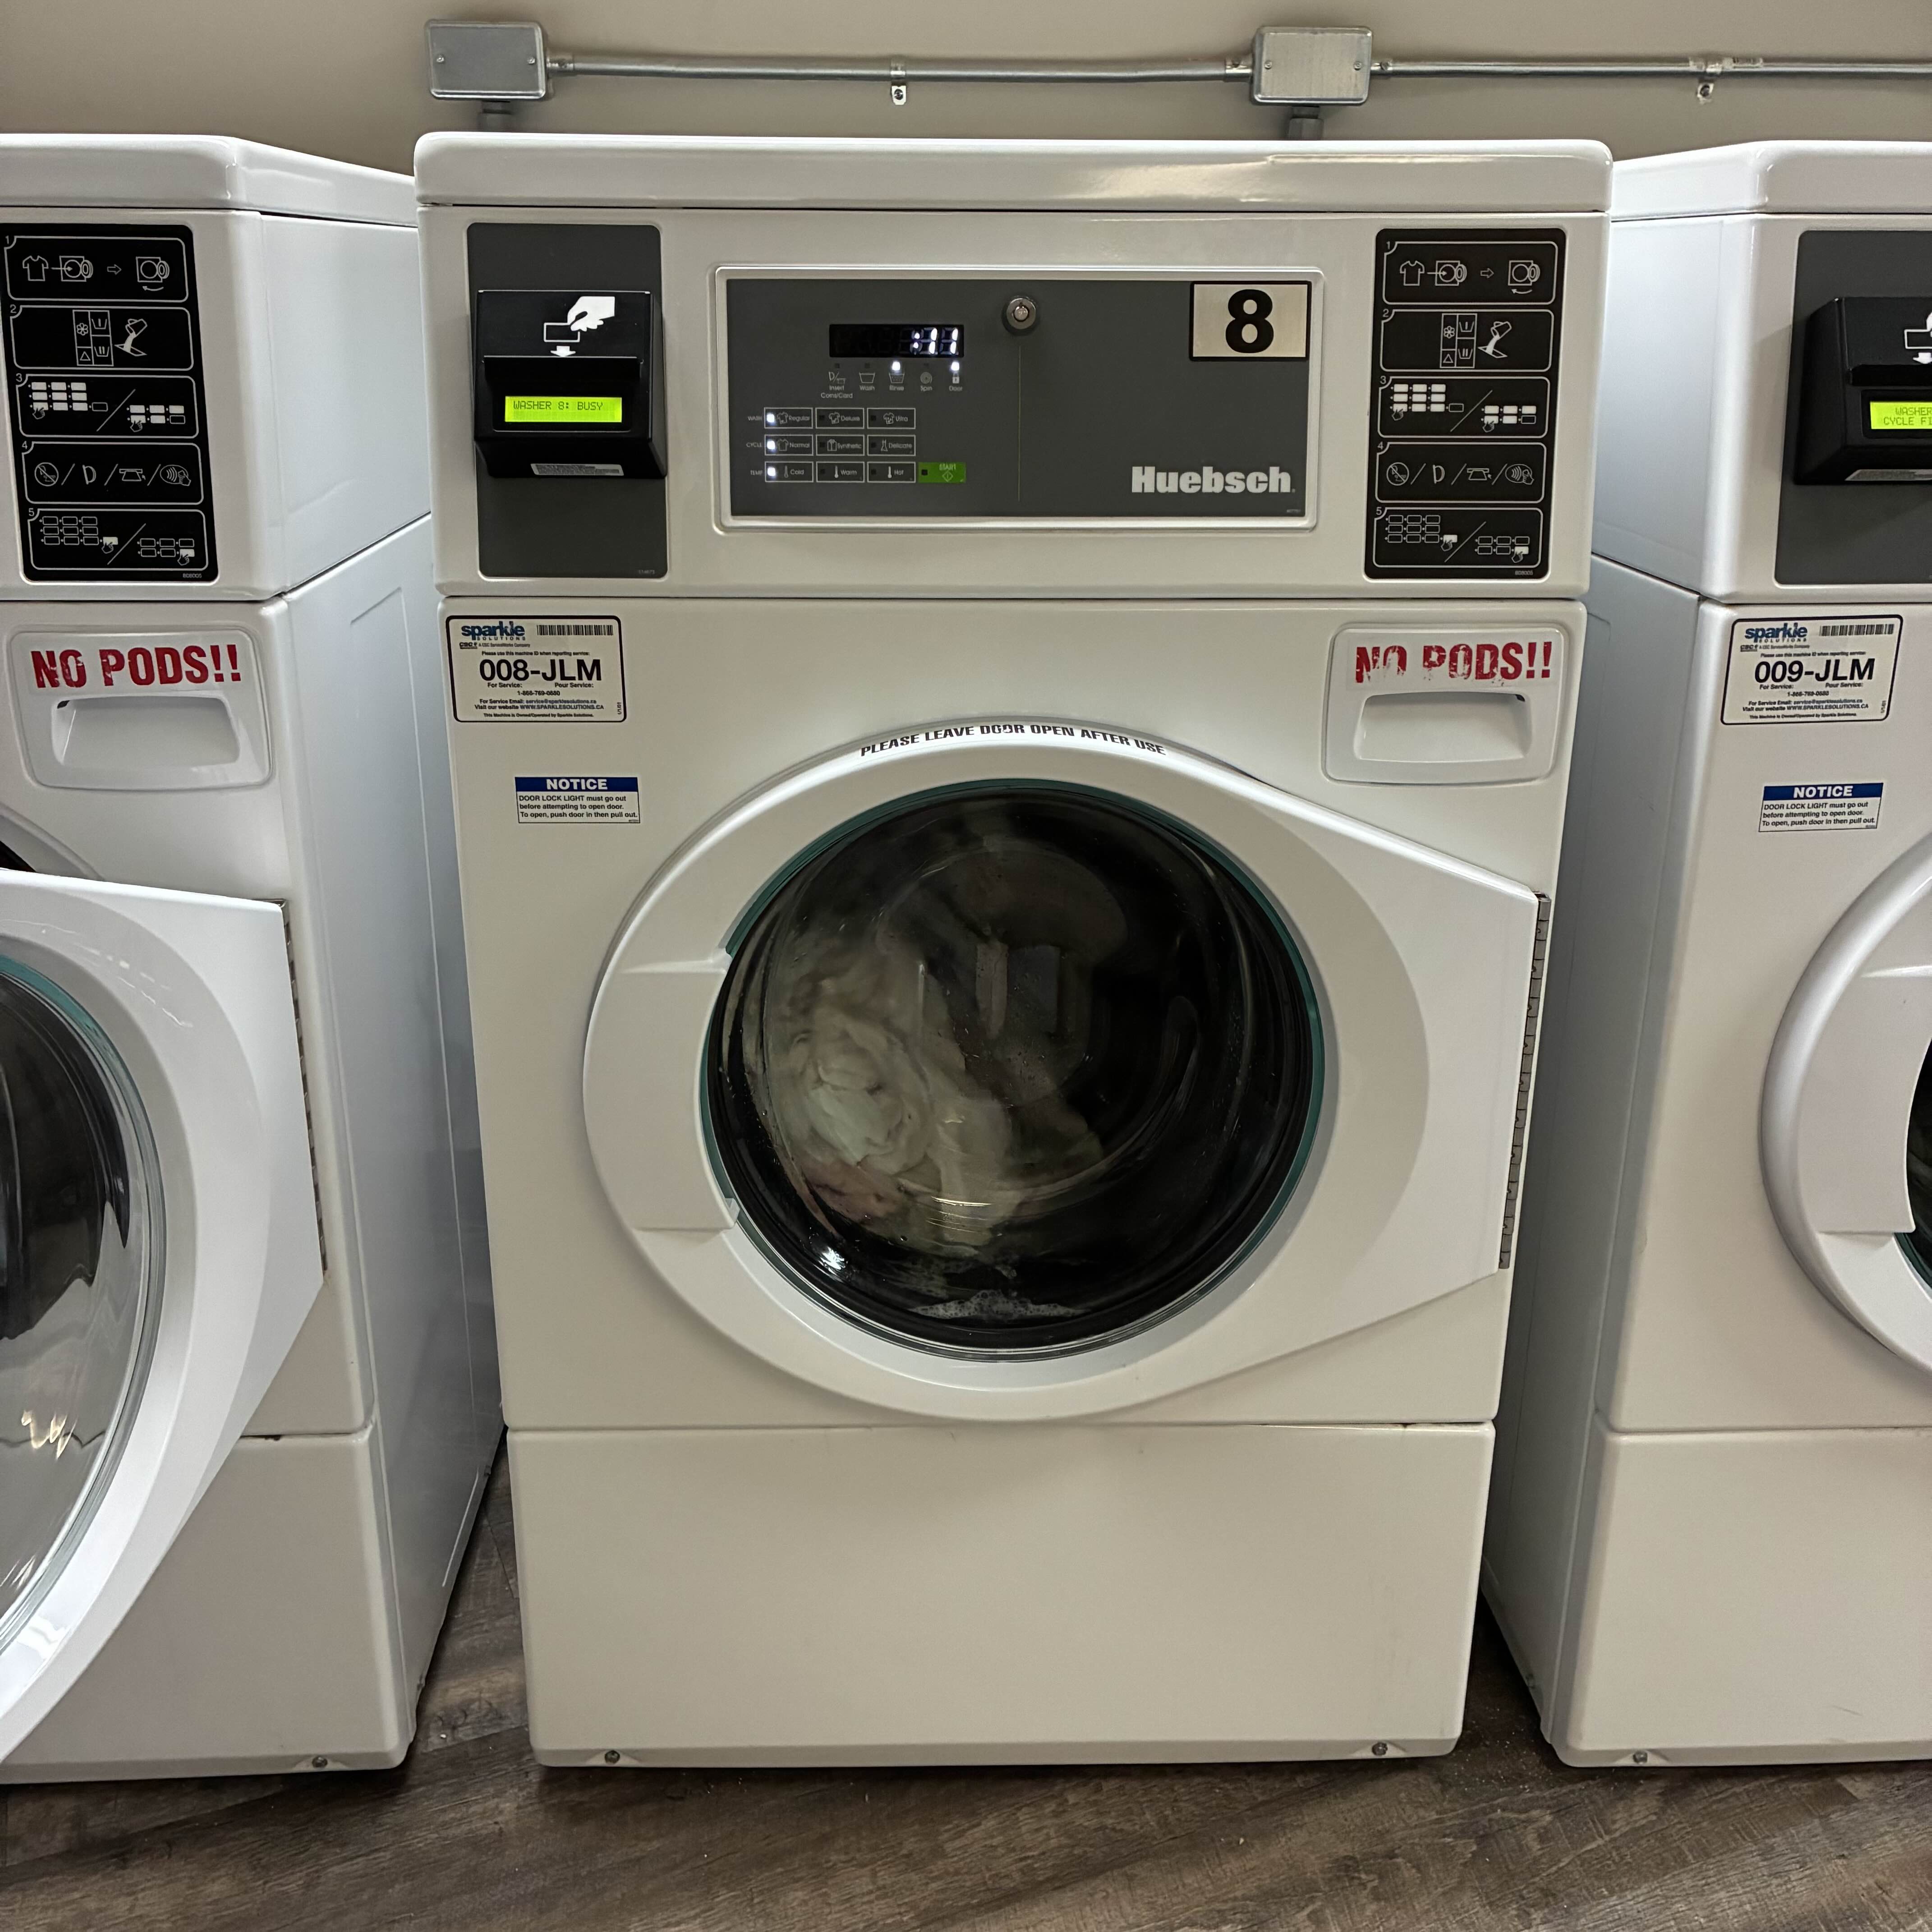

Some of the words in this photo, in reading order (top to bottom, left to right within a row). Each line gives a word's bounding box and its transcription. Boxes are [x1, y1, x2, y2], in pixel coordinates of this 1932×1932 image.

[5, 235, 9, 244] 1
[10, 304, 17, 313] 2
[1225, 289, 1274, 353] 8
[16, 373, 22, 382] 3
[1380, 376, 1386, 384] 3
[513, 400, 552, 409] WASHER
[558, 401, 569, 410] 8:
[577, 401, 603, 410] BUSY
[1884, 417, 1915, 425] CYCLE
[22, 442, 28, 450] 4
[1132, 466, 1291, 494] Huebsch
[28, 508, 34, 516] 5
[461, 621, 525, 640] sparkle
[1744, 622, 1808, 643] sparkle
[31, 649, 87, 688] NO
[99, 644, 241, 686] PODS!!
[1423, 641, 1552, 681] PODS!!
[479, 659, 602, 681] 008-JLM
[1755, 658, 1875, 683] 009-JLM
[860, 733, 920, 757] PLEASE
[925, 725, 975, 741] LEAVE
[1031, 724, 1075, 737] OPEN
[1081, 728, 1131, 746] AFTER
[1135, 739, 1166, 755] USE
[546, 779, 608, 790] NOTICE
[1794, 786, 1853, 798] NOTICE
